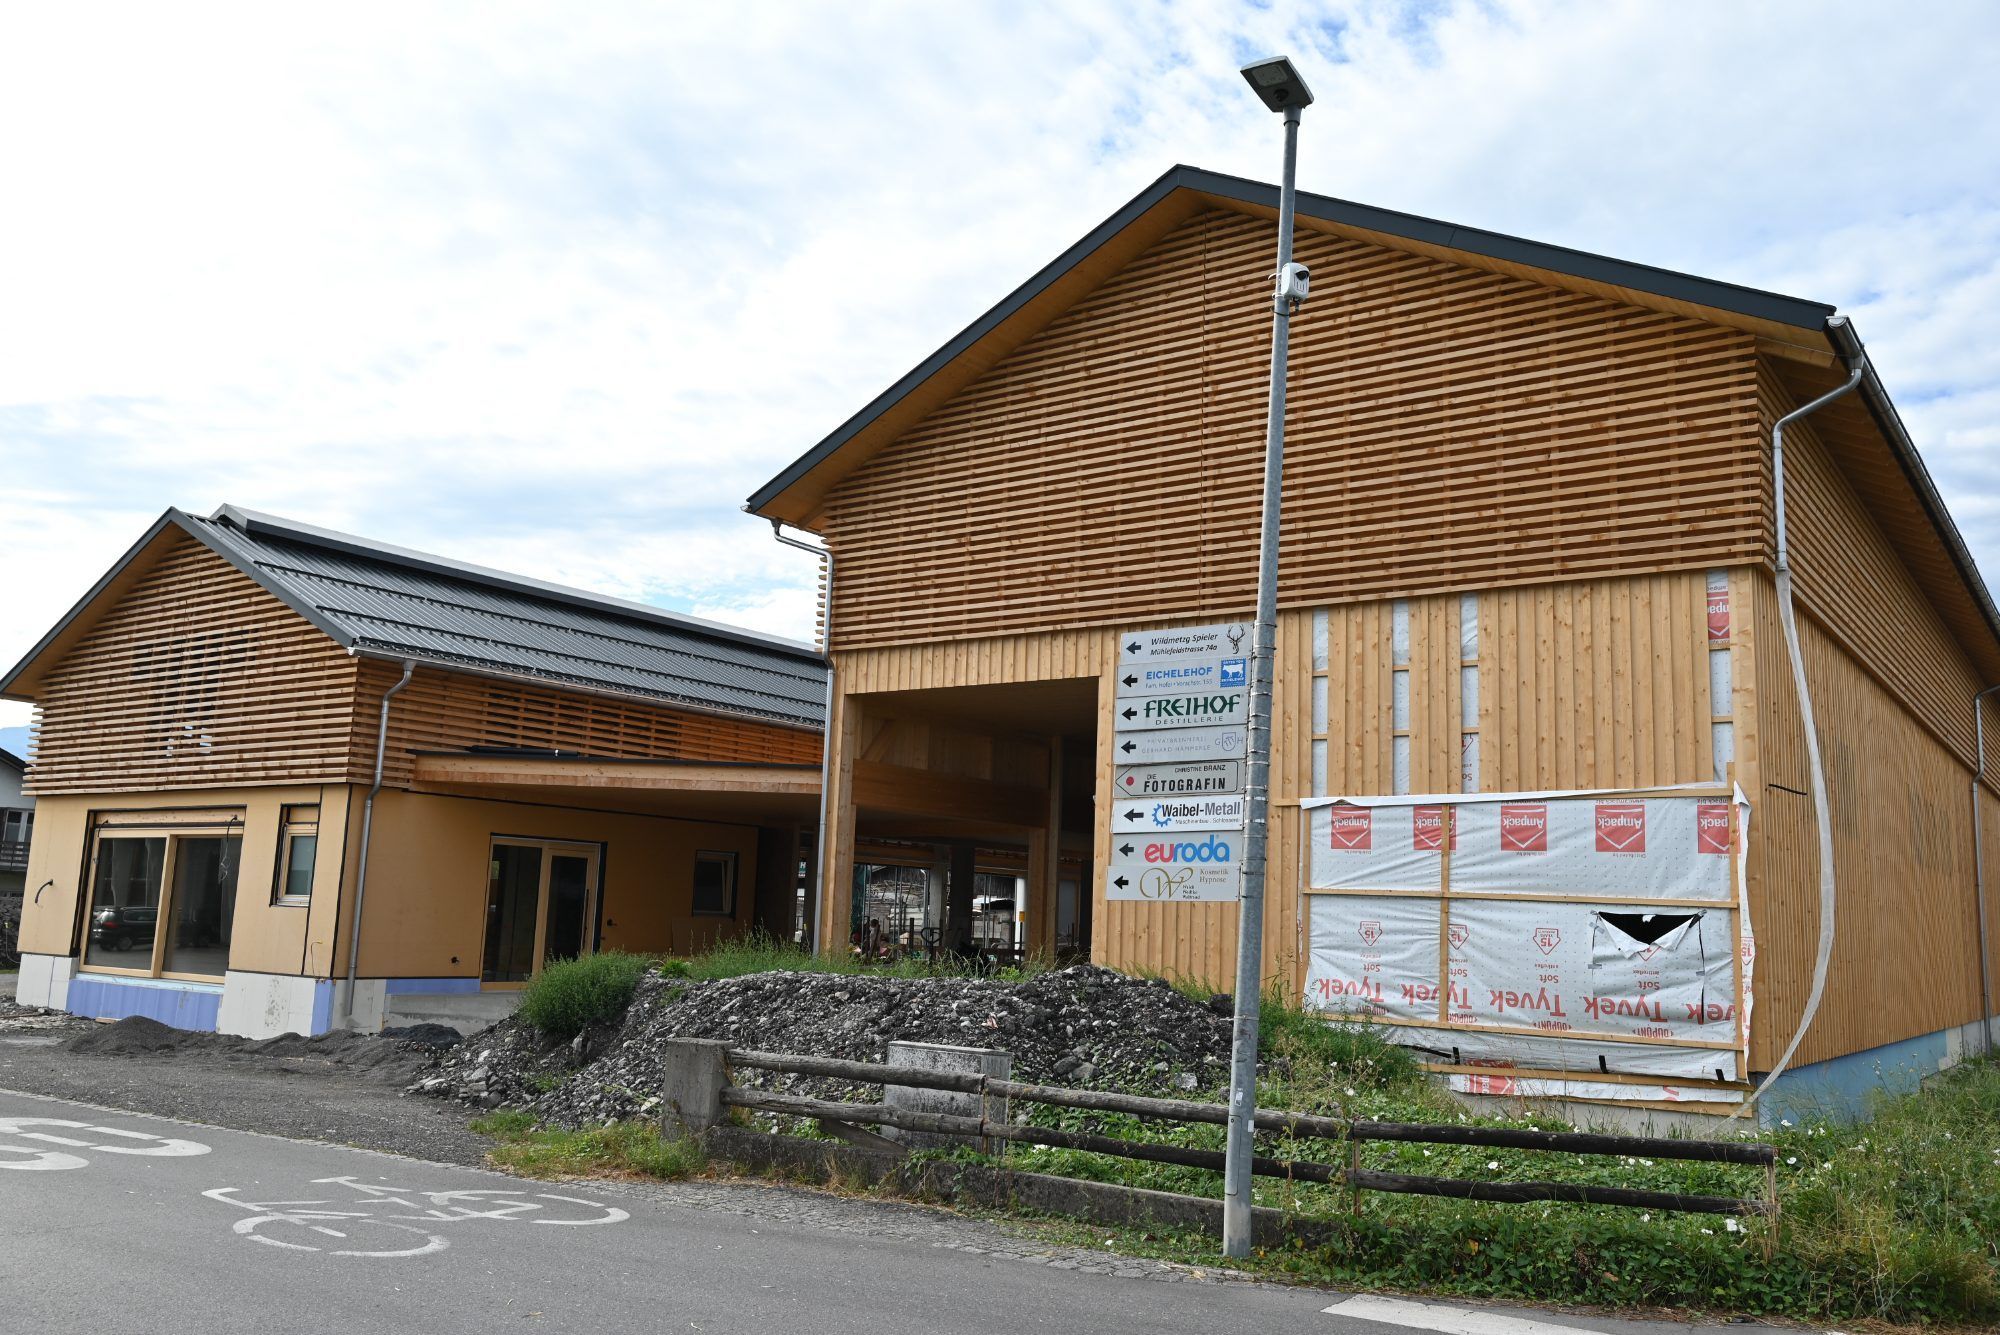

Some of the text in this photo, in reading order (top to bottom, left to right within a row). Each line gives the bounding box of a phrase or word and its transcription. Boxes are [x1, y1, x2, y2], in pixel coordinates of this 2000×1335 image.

[1151, 633, 1218, 646] Wildmetzg Spieler
[1150, 646, 1204, 656] Mühlefeldstrasse
[1146, 666, 1213, 680] EICHELEHOF
[1143, 694, 1240, 718] FREIHOF
[1155, 716, 1223, 725] DESTILLERIE
[1203, 764, 1226, 772] BRANZ
[1143, 777, 1226, 792] FOTOGRAFIN
[1161, 801, 1241, 817] Waibel-Metall
[1333, 815, 1369, 830] Ampack
[1502, 814, 1545, 829] Ampack
[1597, 814, 1643, 830] Ampack
[1699, 815, 1729, 830] pack
[1144, 834, 1230, 863] euroda
[1200, 876, 1226, 885] Hypnose
[1364, 930, 1375, 939] 15
[1451, 933, 1462, 942] 15
[1540, 938, 1553, 947] 15
[1741, 947, 1752, 957] 15
[1363, 963, 1381, 972] Soft
[1449, 968, 1468, 977] Soft
[1539, 974, 1559, 984] Soft
[1318, 976, 1384, 1004] Tyvek
[1638, 981, 1660, 990] Soft
[1489, 987, 1567, 1017] Tyvek
[1583, 994, 1668, 1023] Tyvek
[1685, 1003, 1736, 1025] vek
[1536, 1020, 1567, 1031] DUPONT
[1636, 1027, 1669, 1038] DUPONT
